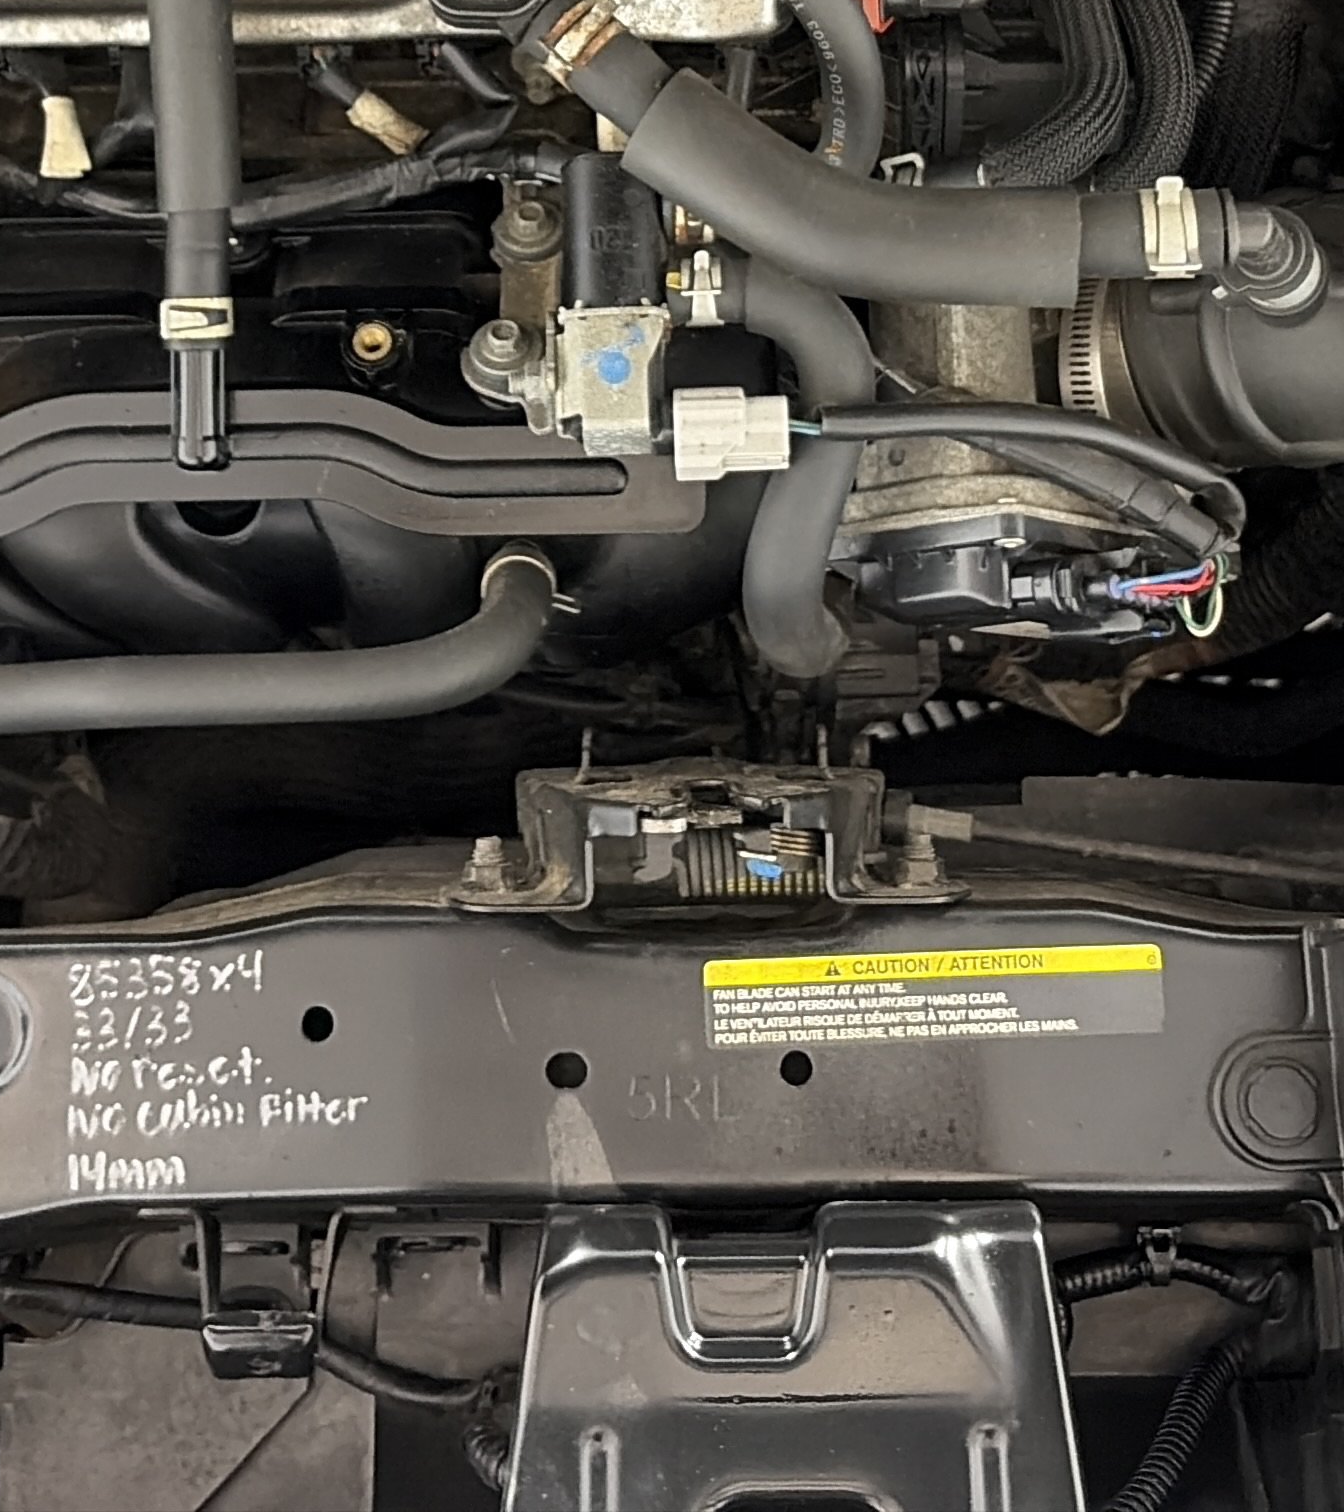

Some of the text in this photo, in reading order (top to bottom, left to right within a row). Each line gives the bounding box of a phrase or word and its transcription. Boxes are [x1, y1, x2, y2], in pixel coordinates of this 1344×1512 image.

[852, 954, 1044, 975] CAUTION / ATTENTION
[713, 983, 906, 1000] FAN BLADE CAN START AT ANY TIME.
[713, 1004, 729, 1014] TO
[732, 1002, 760, 1013] HELP
[762, 1001, 796, 1012] AVOID
[798, 999, 857, 1011] PERSONAL
[928, 994, 967, 1005] HANDS
[969, 992, 1008, 1004] CLEAR.
[714, 1020, 729, 1030] LE
[804, 1015, 846, 1027] RISQUE
[848, 1014, 862, 1024] DE
[865, 1010, 925, 1023] DÉMARRER
[928, 1007, 936, 1021] À
[937, 1010, 967, 1020] TOUT
[969, 1008, 1020, 1019] MOMENT.
[715, 1033, 748, 1044] POUR
[750, 1030, 787, 1043] ÉVITER
[790, 1031, 825, 1041] TOUTE
[889, 1027, 905, 1037] NE
[907, 1026, 928, 1036] PAS
[931, 1025, 946, 1036] EN
[948, 1022, 1019, 1035] APPROCHER
[1019, 1021, 1040, 1032] LES
[1041, 1019, 1079, 1031] MAINS.
